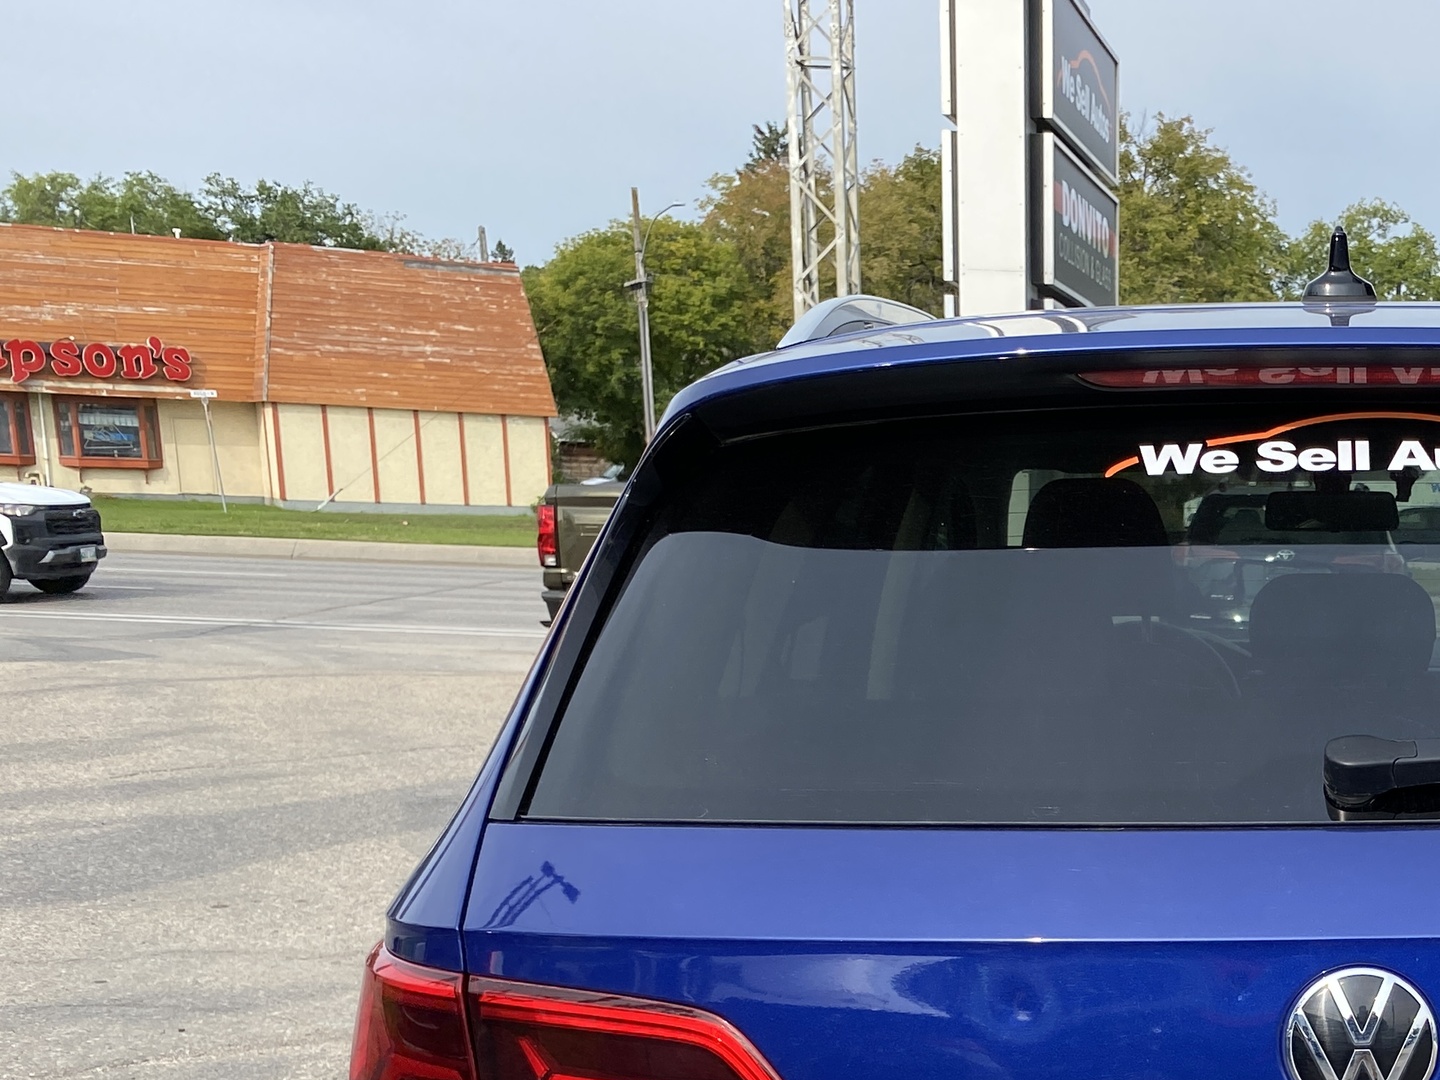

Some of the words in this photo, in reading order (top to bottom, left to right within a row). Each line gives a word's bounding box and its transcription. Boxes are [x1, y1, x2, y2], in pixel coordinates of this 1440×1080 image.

[1061, 56, 1075, 104] We
[1075, 74, 1090, 122] Sell
[1090, 92, 1110, 144] Autos
[1061, 179, 1109, 259] DONVITO
[0, 336, 192, 384] pson's
[1139, 442, 1239, 476] We
[1255, 440, 1370, 472] Sell
